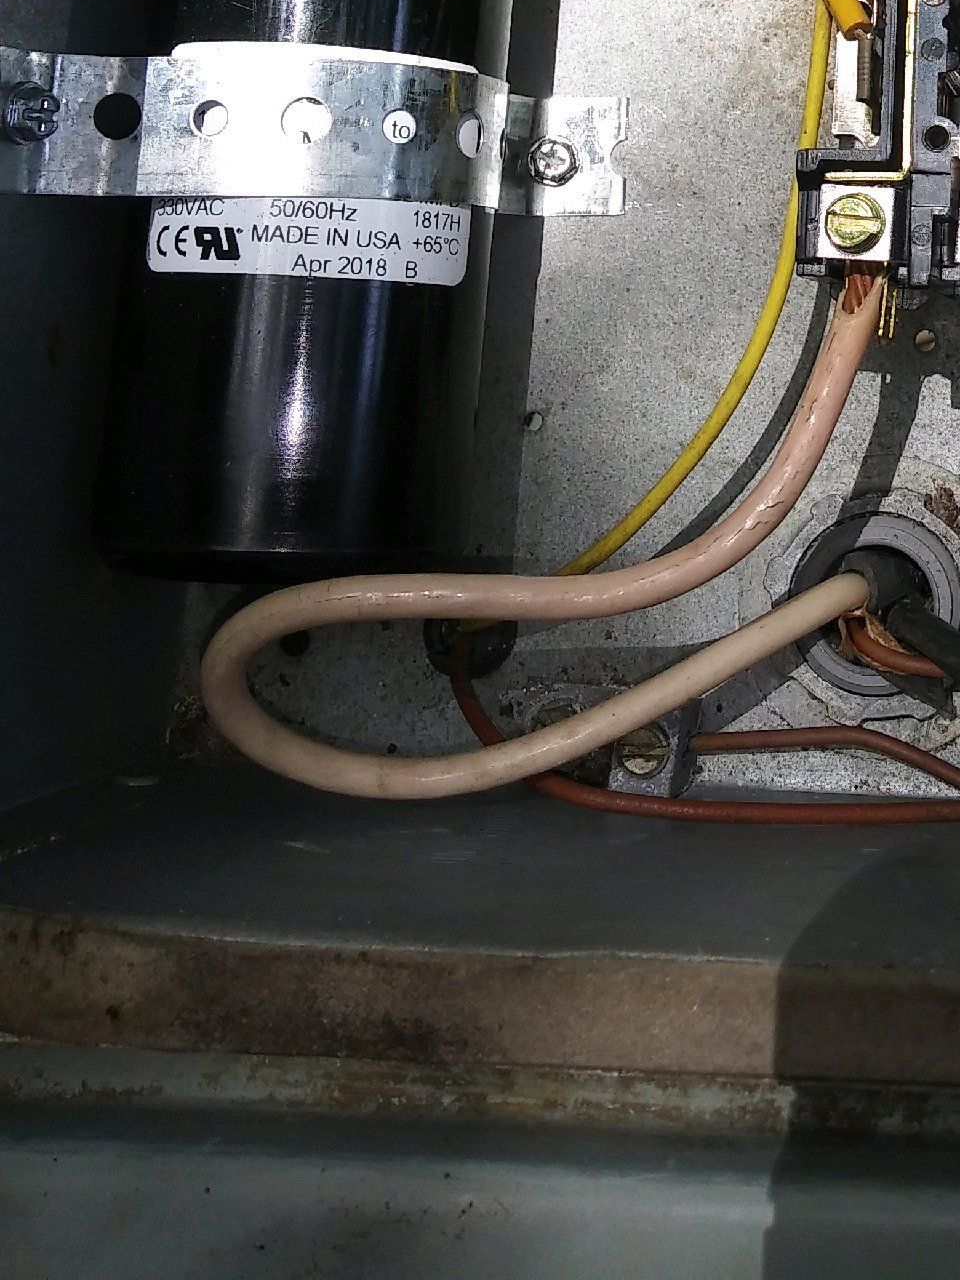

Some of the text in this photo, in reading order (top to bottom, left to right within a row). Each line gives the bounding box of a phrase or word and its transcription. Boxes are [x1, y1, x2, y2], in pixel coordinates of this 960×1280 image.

[269, 198, 358, 222] 50/60Hz
[413, 209, 461, 232] 1817H
[251, 223, 402, 251] MADE IN USA
[291, 253, 418, 279] Apr 2018 B
